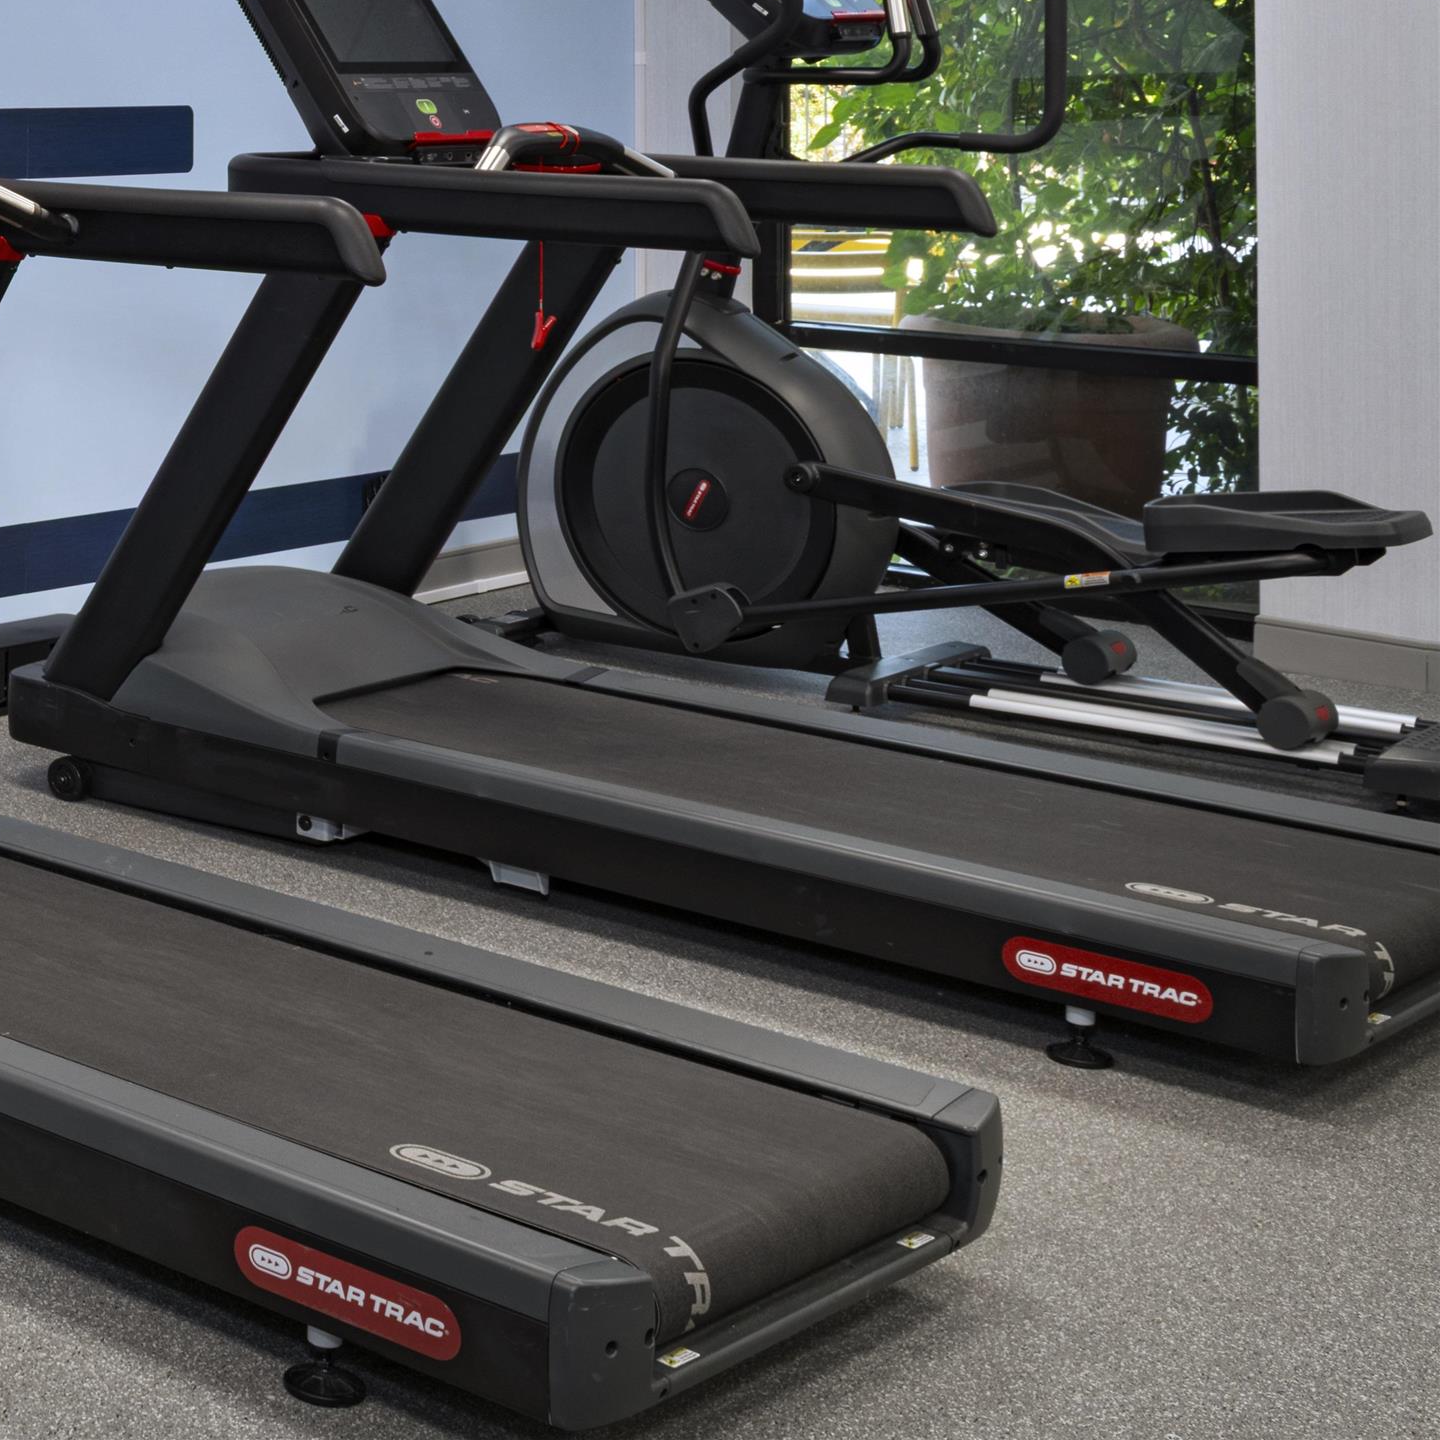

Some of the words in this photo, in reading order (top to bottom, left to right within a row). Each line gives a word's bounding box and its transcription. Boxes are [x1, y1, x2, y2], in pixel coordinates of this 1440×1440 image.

[1217, 902, 1367, 937] STAR
[1059, 962, 1126, 990] STAR
[1128, 978, 1200, 1007] TRAC
[488, 1179, 660, 1237] STAR
[295, 1265, 366, 1307] STAR
[369, 1293, 446, 1339] TRAC
